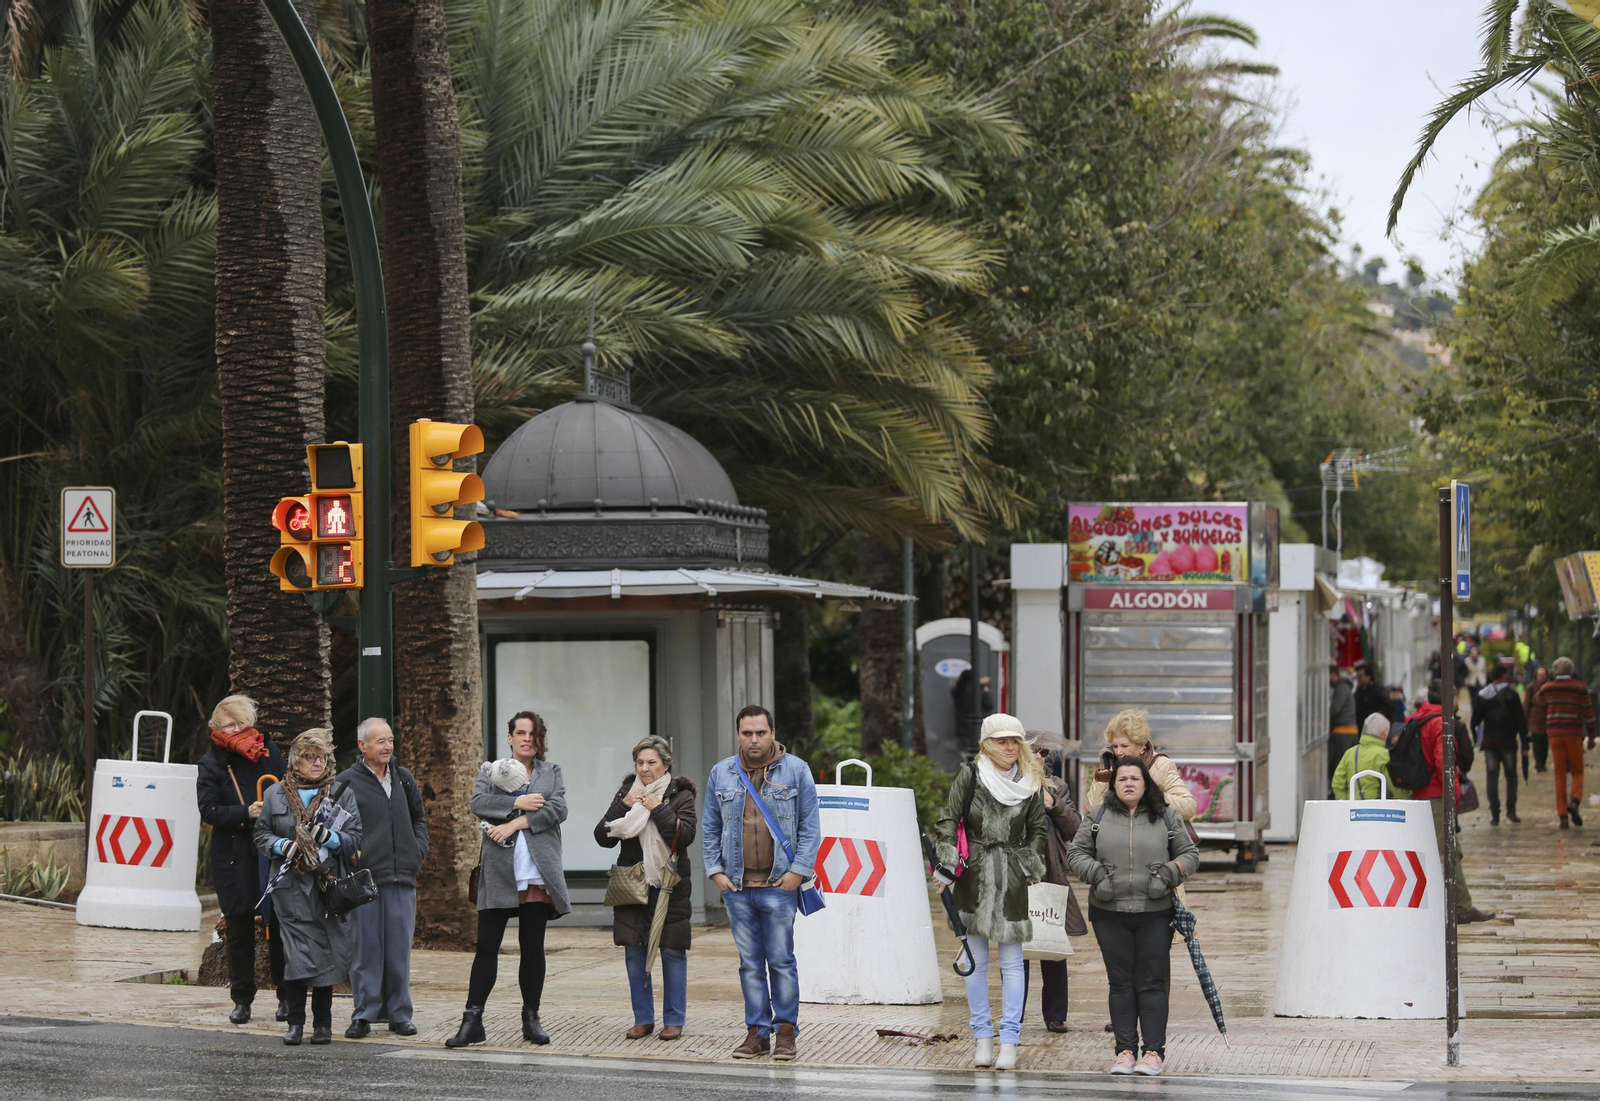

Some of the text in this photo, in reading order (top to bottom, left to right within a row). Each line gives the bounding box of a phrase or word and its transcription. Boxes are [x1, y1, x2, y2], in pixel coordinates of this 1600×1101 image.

[1071, 509, 1242, 536] ALGODONES DULCES
[1160, 524, 1241, 544] Y BUÑUELOS
[338, 545, 353, 583] 2
[1109, 588, 1208, 608] ALGODÓN
